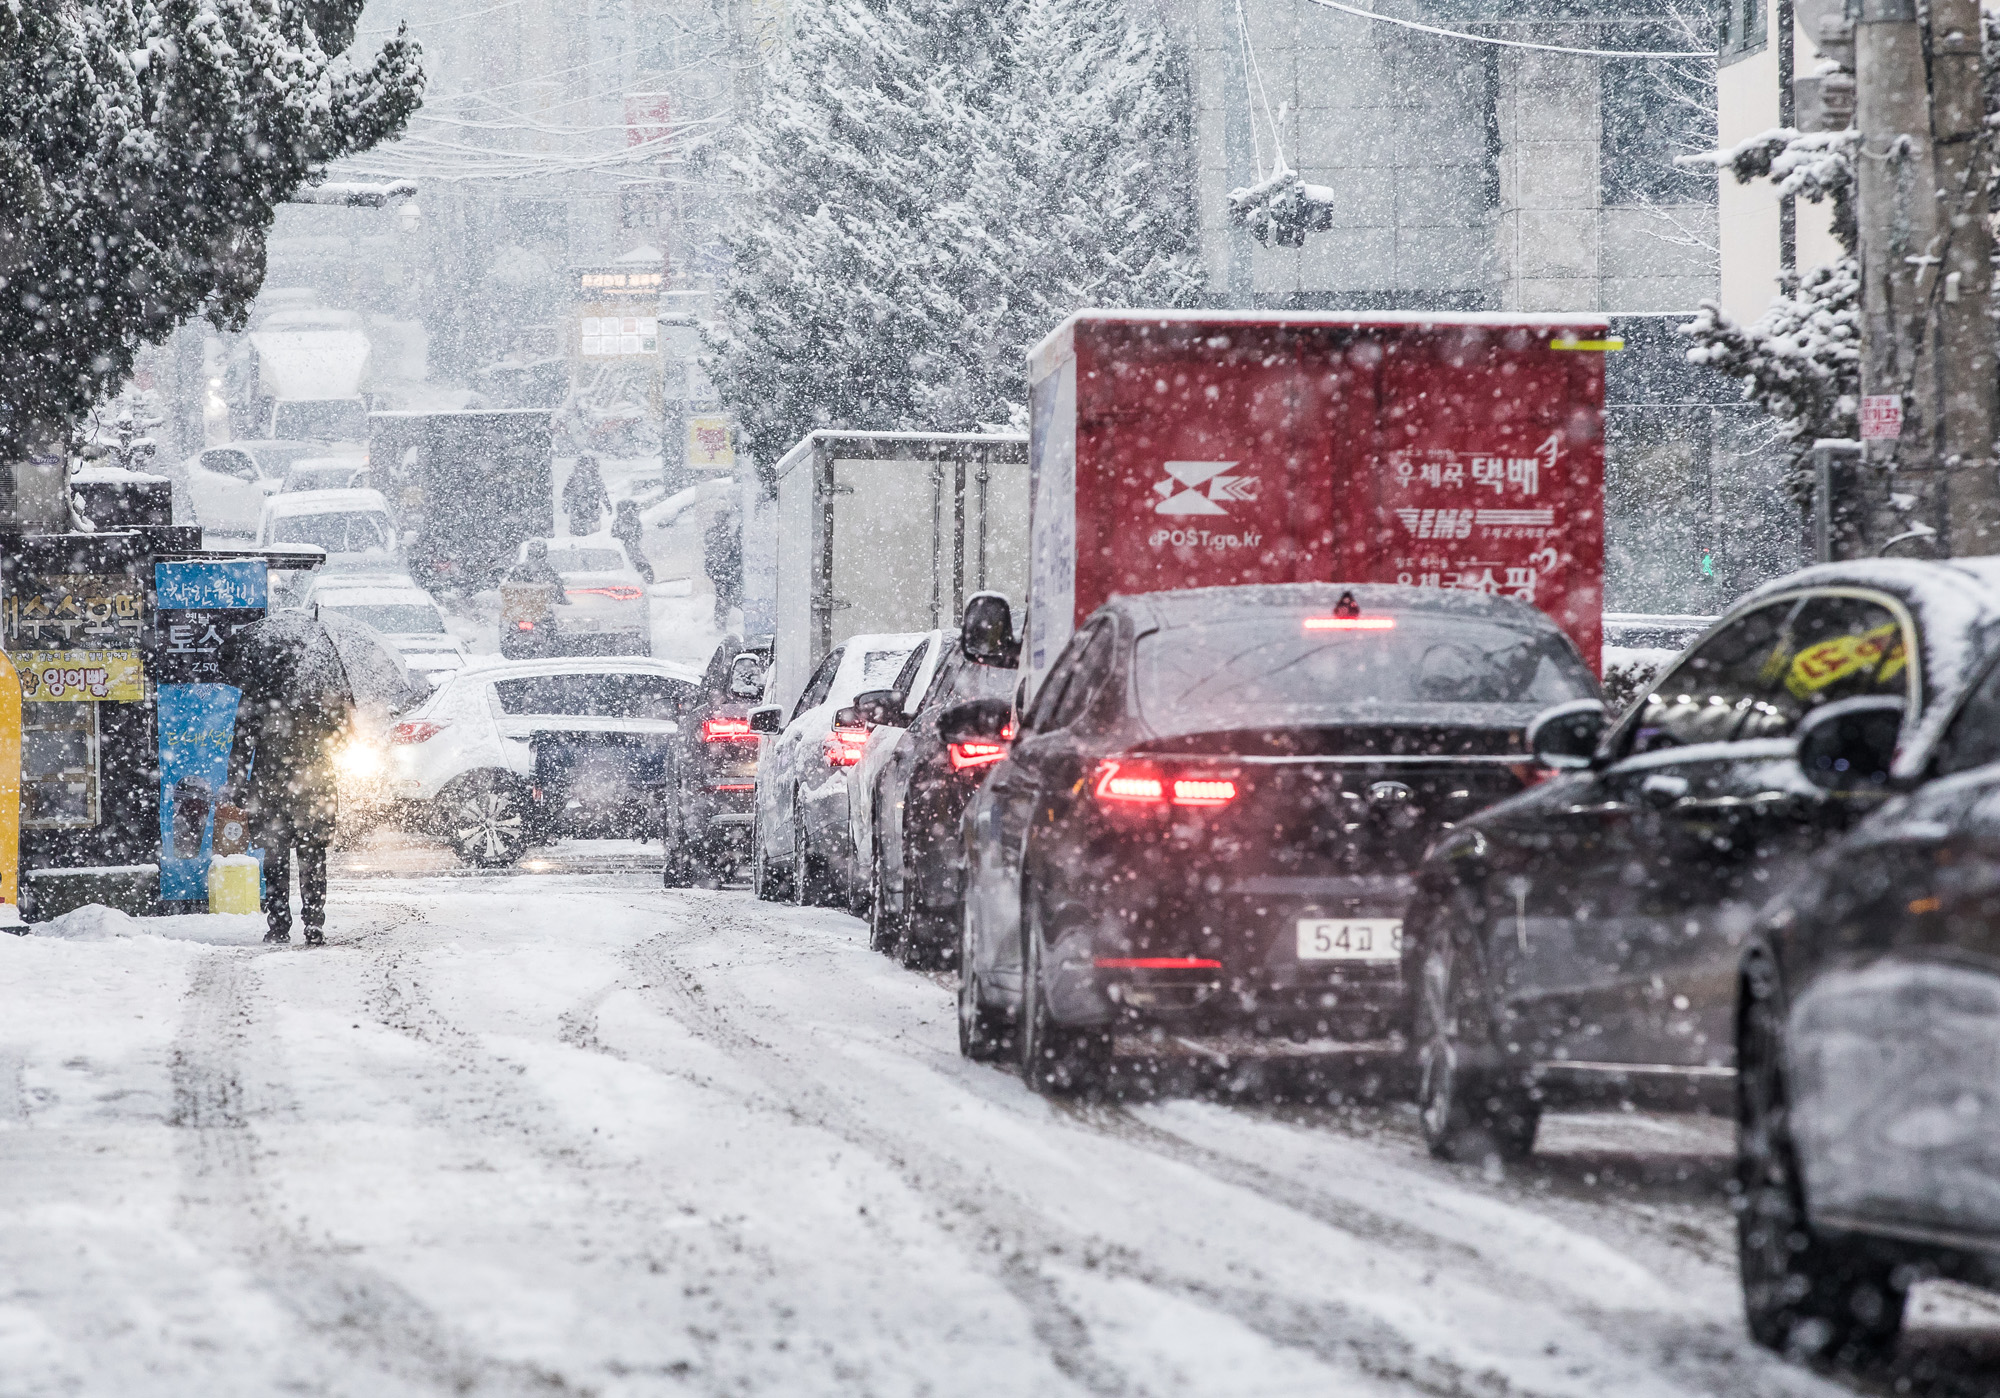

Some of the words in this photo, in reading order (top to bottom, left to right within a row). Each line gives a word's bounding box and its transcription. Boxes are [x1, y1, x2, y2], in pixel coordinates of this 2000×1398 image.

[1418, 508, 1474, 539] EMS
[1148, 530, 1262, 550] ePOST.go.kr
[185, 612, 210, 626] 옛날
